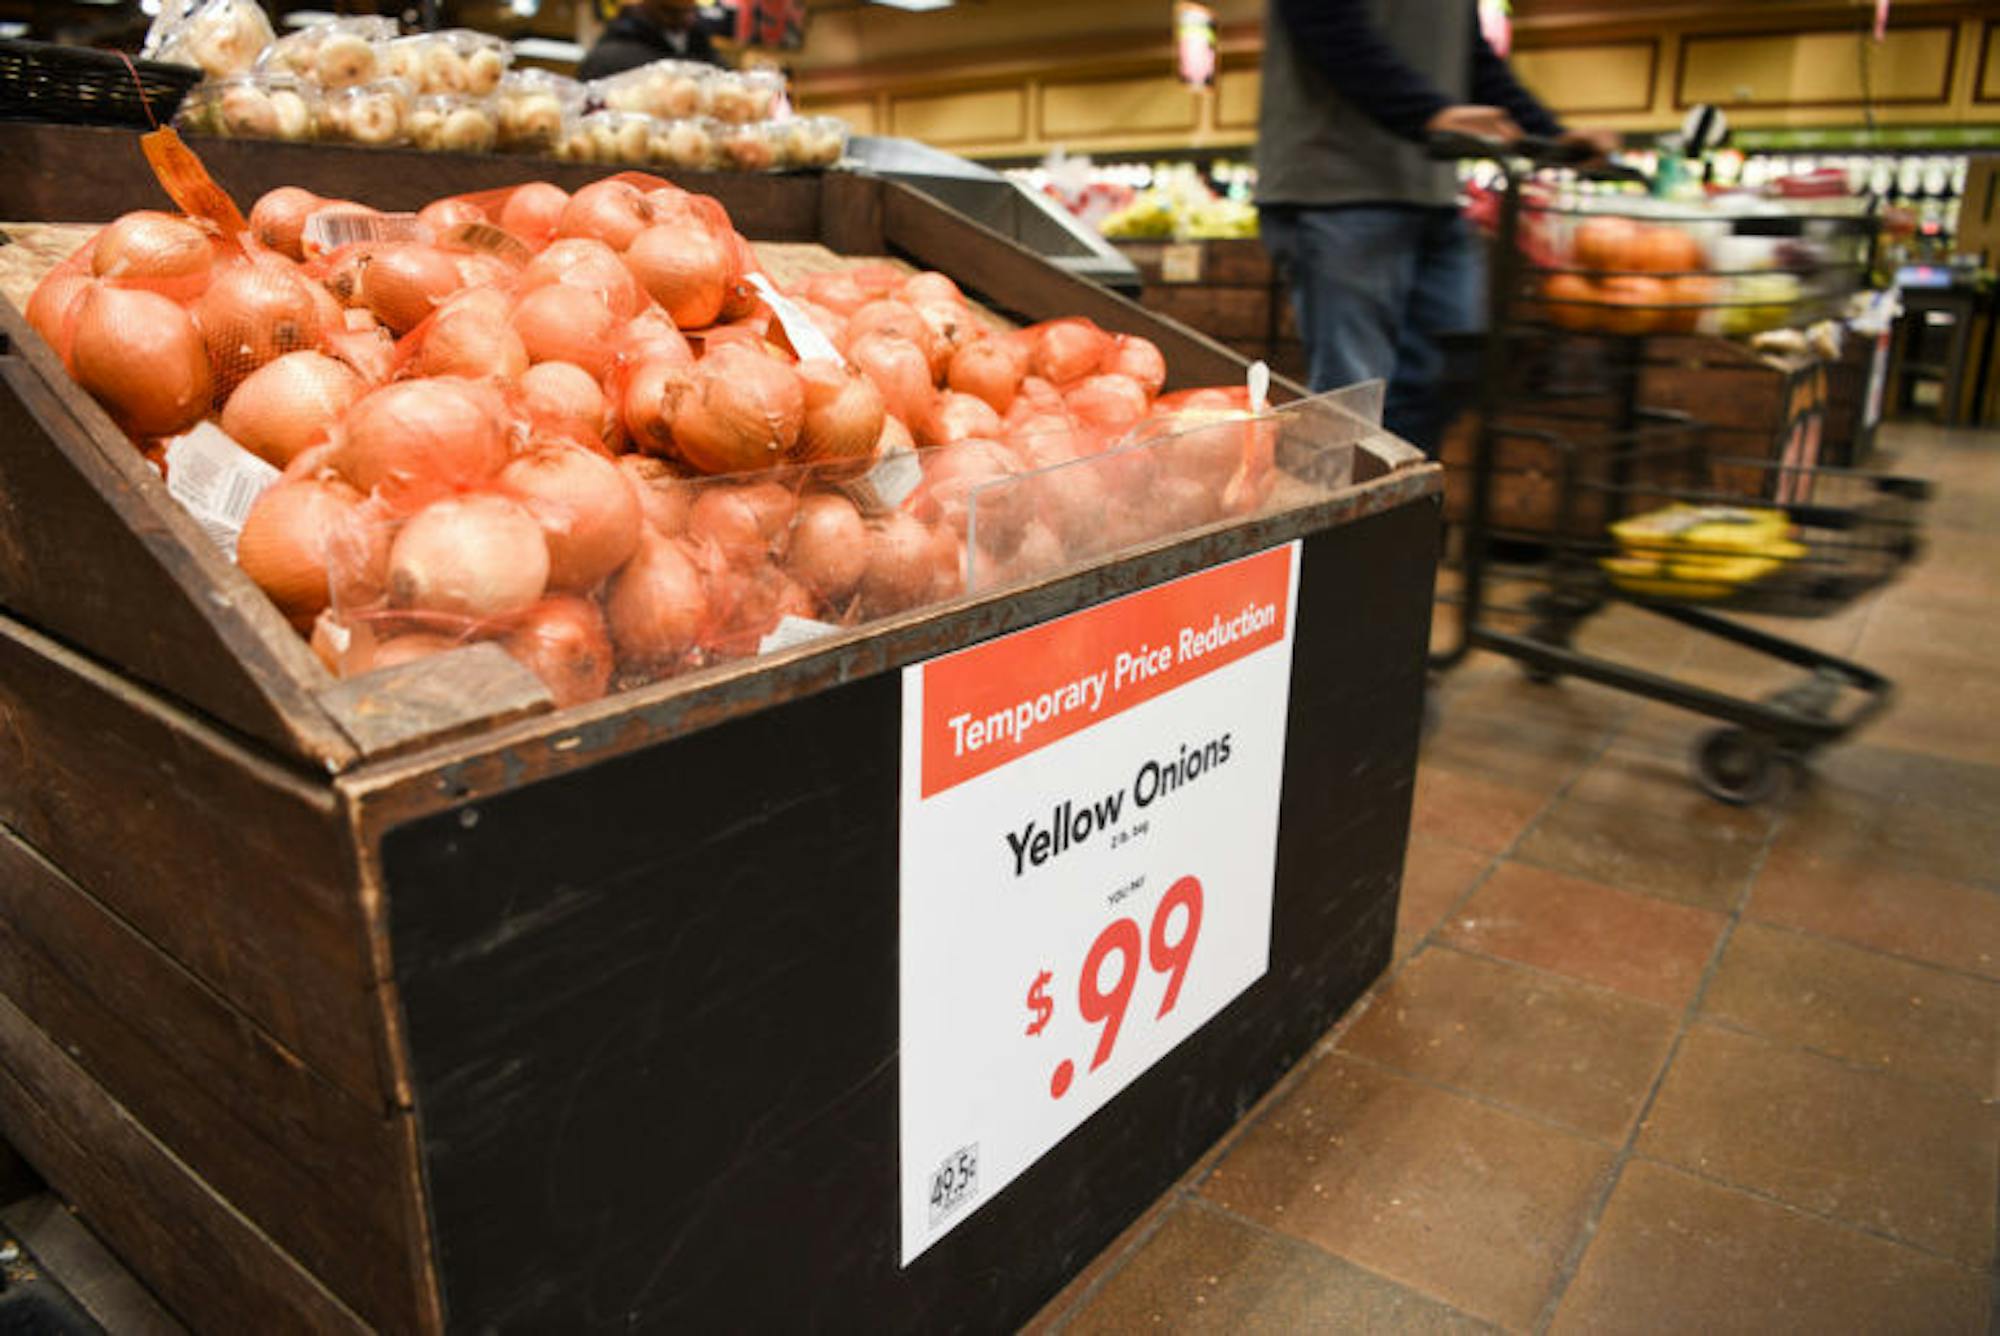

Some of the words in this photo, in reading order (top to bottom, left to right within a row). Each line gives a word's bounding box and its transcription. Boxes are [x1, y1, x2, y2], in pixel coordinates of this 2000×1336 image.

[948, 671, 1108, 757] Temporary
[1113, 645, 1172, 691] Price
[1178, 602, 1276, 662] Reduction
[1006, 789, 1125, 877] Yellow
[1134, 733, 1231, 808] Onions
